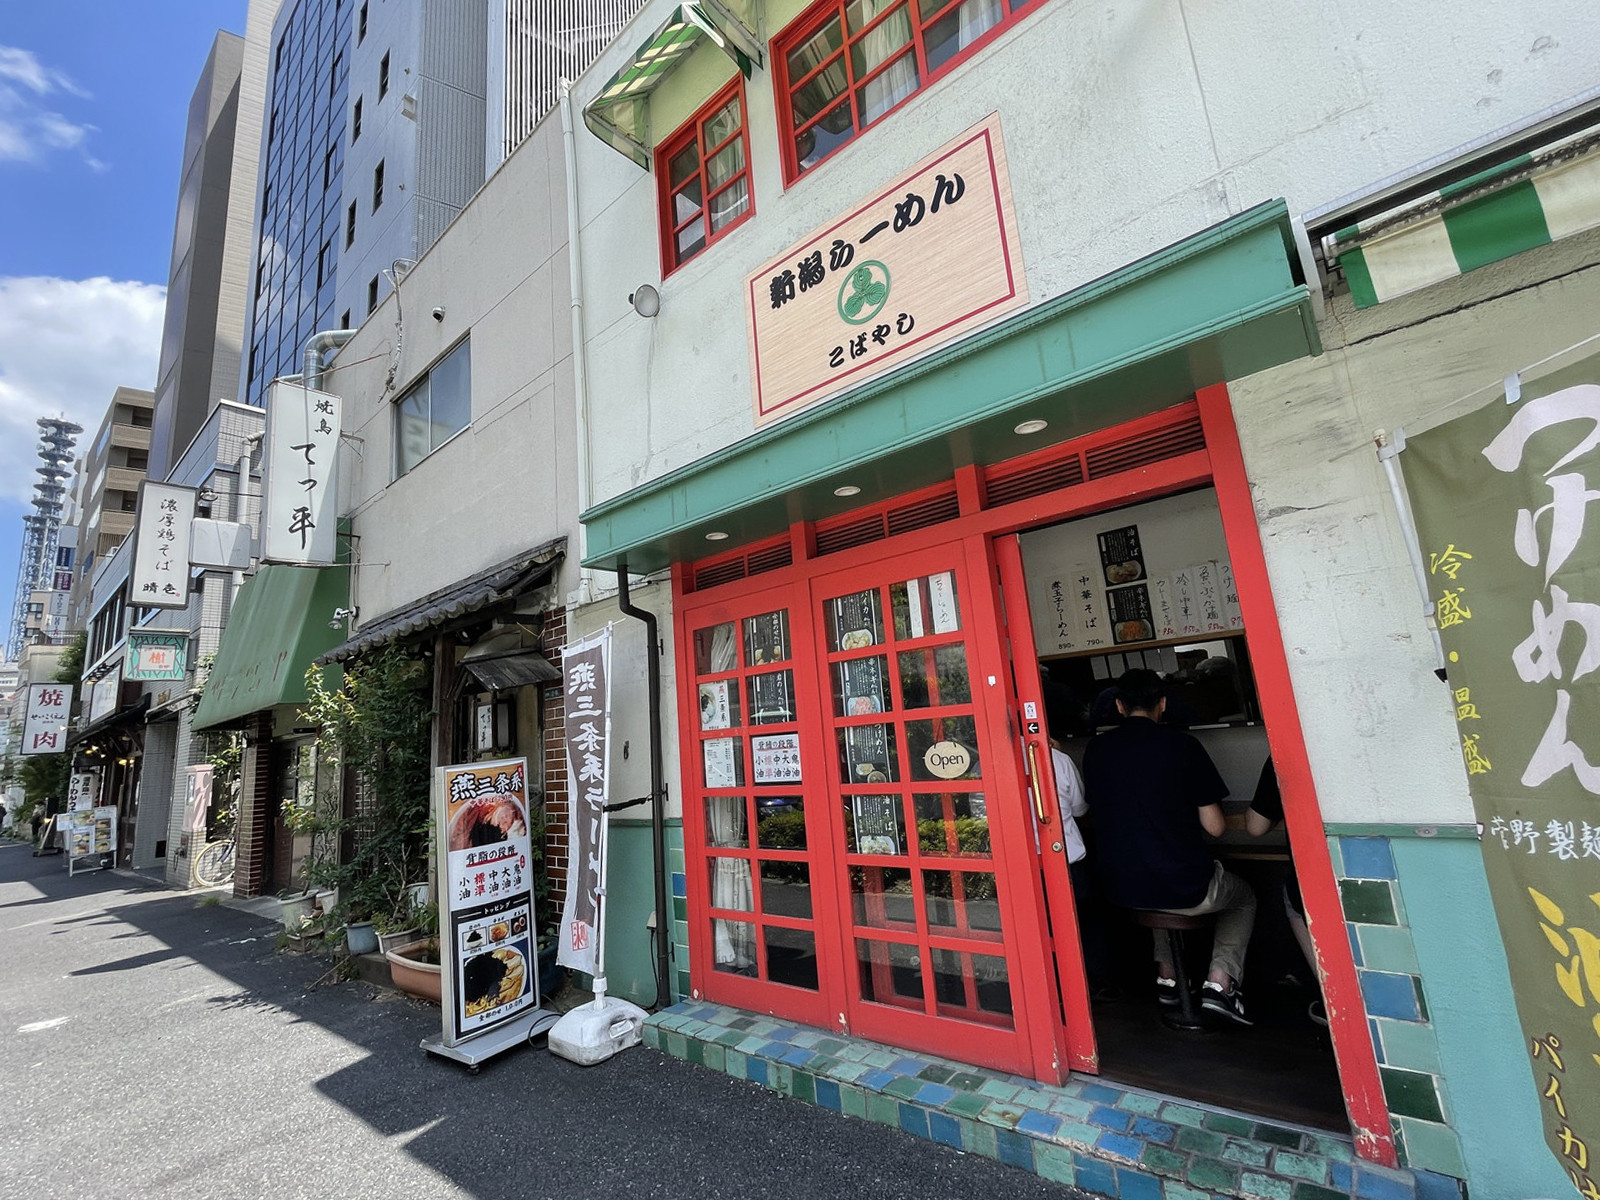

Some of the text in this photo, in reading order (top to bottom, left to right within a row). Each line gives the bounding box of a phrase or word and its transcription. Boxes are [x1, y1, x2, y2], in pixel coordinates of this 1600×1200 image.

[769, 172, 965, 309] 新潟らーめん
[829, 312, 915, 368] こばやし
[314, 400, 334, 435] 焼鳥
[289, 443, 317, 550] てっ平
[156, 499, 179, 571] 濃厚鶏そば
[1078, 576, 1097, 629] 中華そば
[1482, 384, 1600, 795] つけめん
[450, 771, 523, 803] 燕三条系
[930, 753, 964, 770] Open
[484, 902, 511, 914] トッピング
